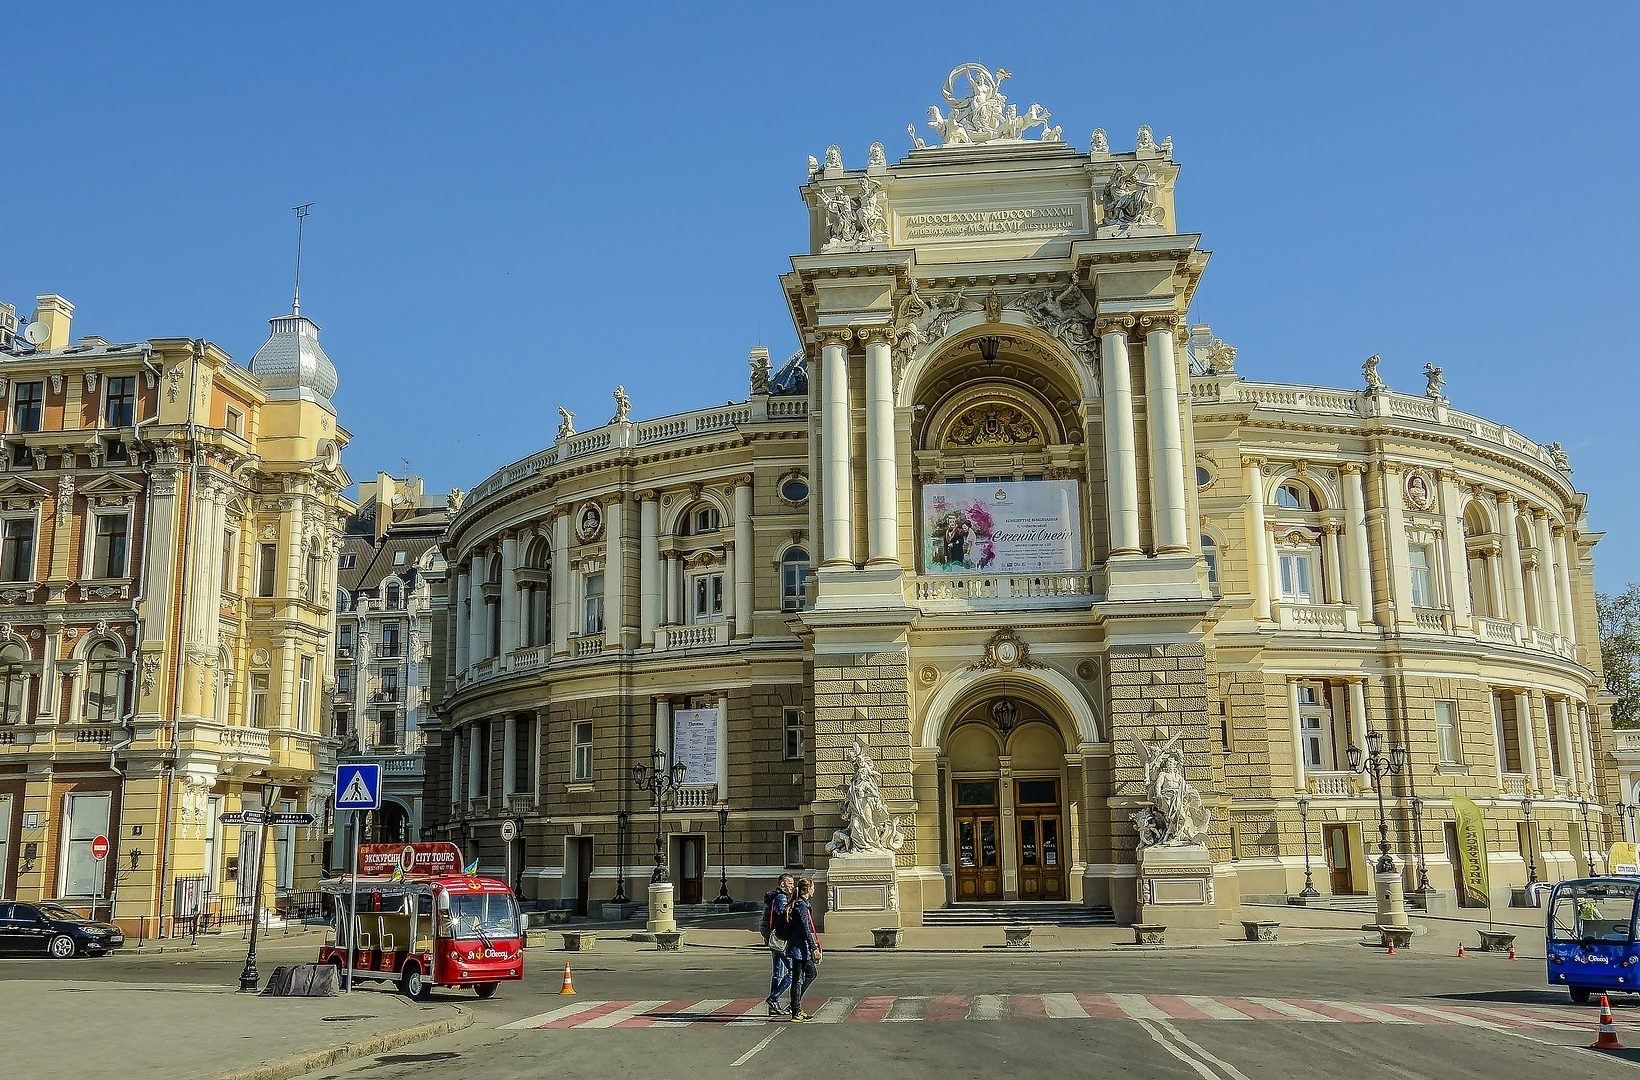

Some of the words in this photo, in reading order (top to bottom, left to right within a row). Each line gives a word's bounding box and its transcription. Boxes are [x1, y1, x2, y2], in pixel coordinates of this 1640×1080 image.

[992, 529, 1037, 542] Євгеній
[415, 853, 431, 862] CITY
[431, 852, 455, 862] TOURS
